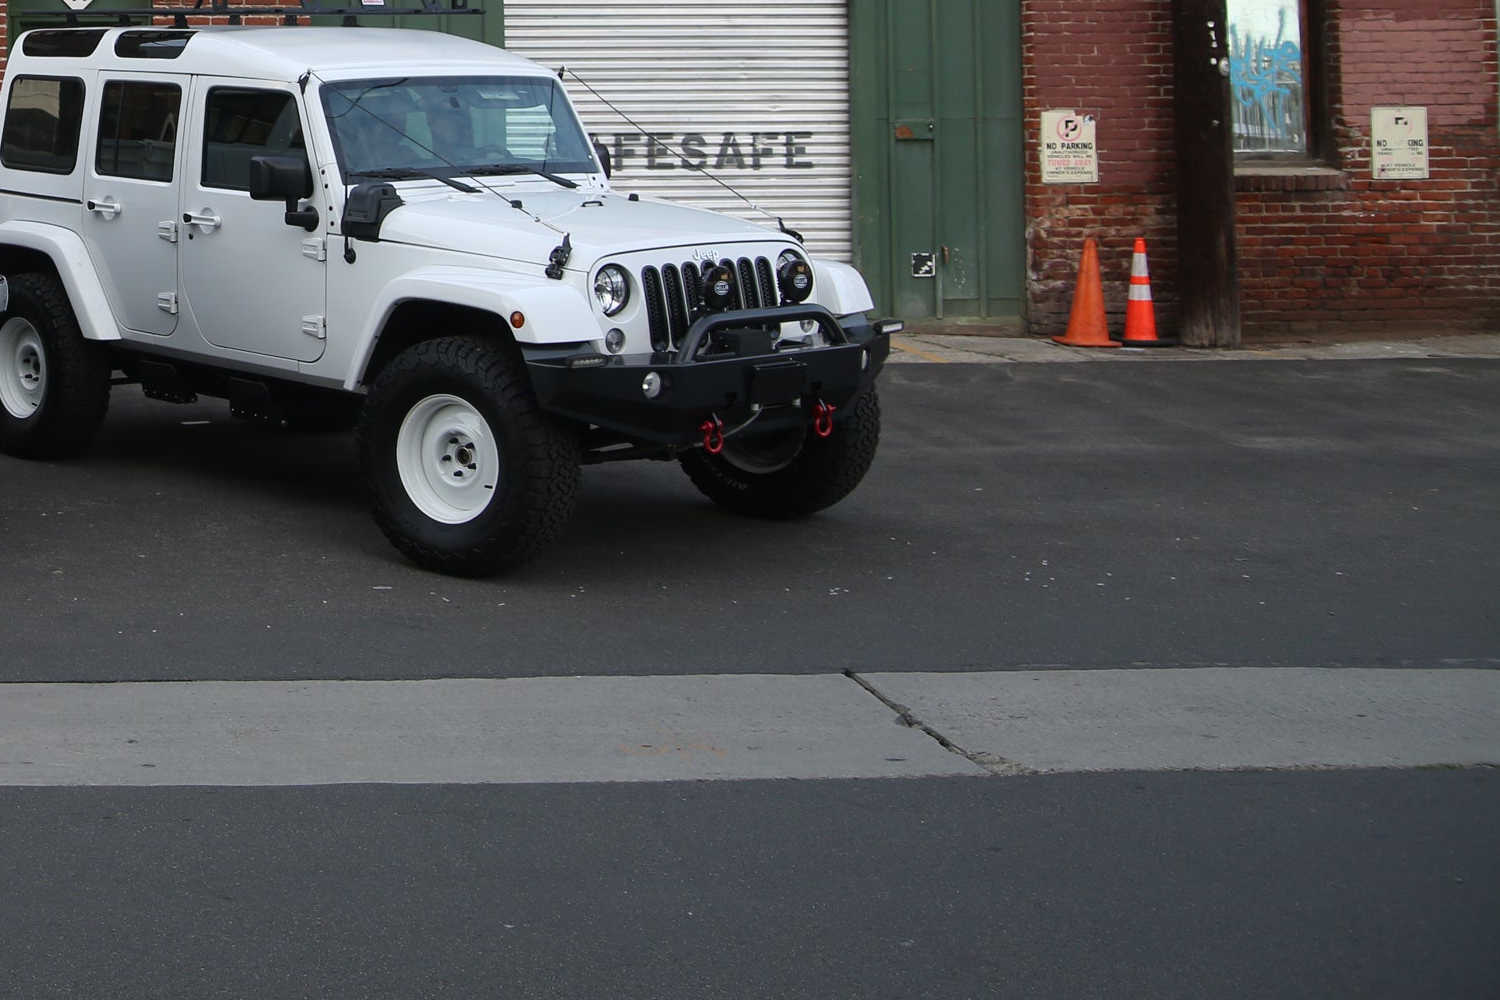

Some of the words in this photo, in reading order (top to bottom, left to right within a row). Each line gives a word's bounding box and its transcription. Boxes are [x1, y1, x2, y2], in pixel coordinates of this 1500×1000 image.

[1046, 142, 1058, 150] NO
[1061, 142, 1094, 150] PARKING
[1376, 139, 1388, 148] NO
[693, 248, 719, 262] Jeep
